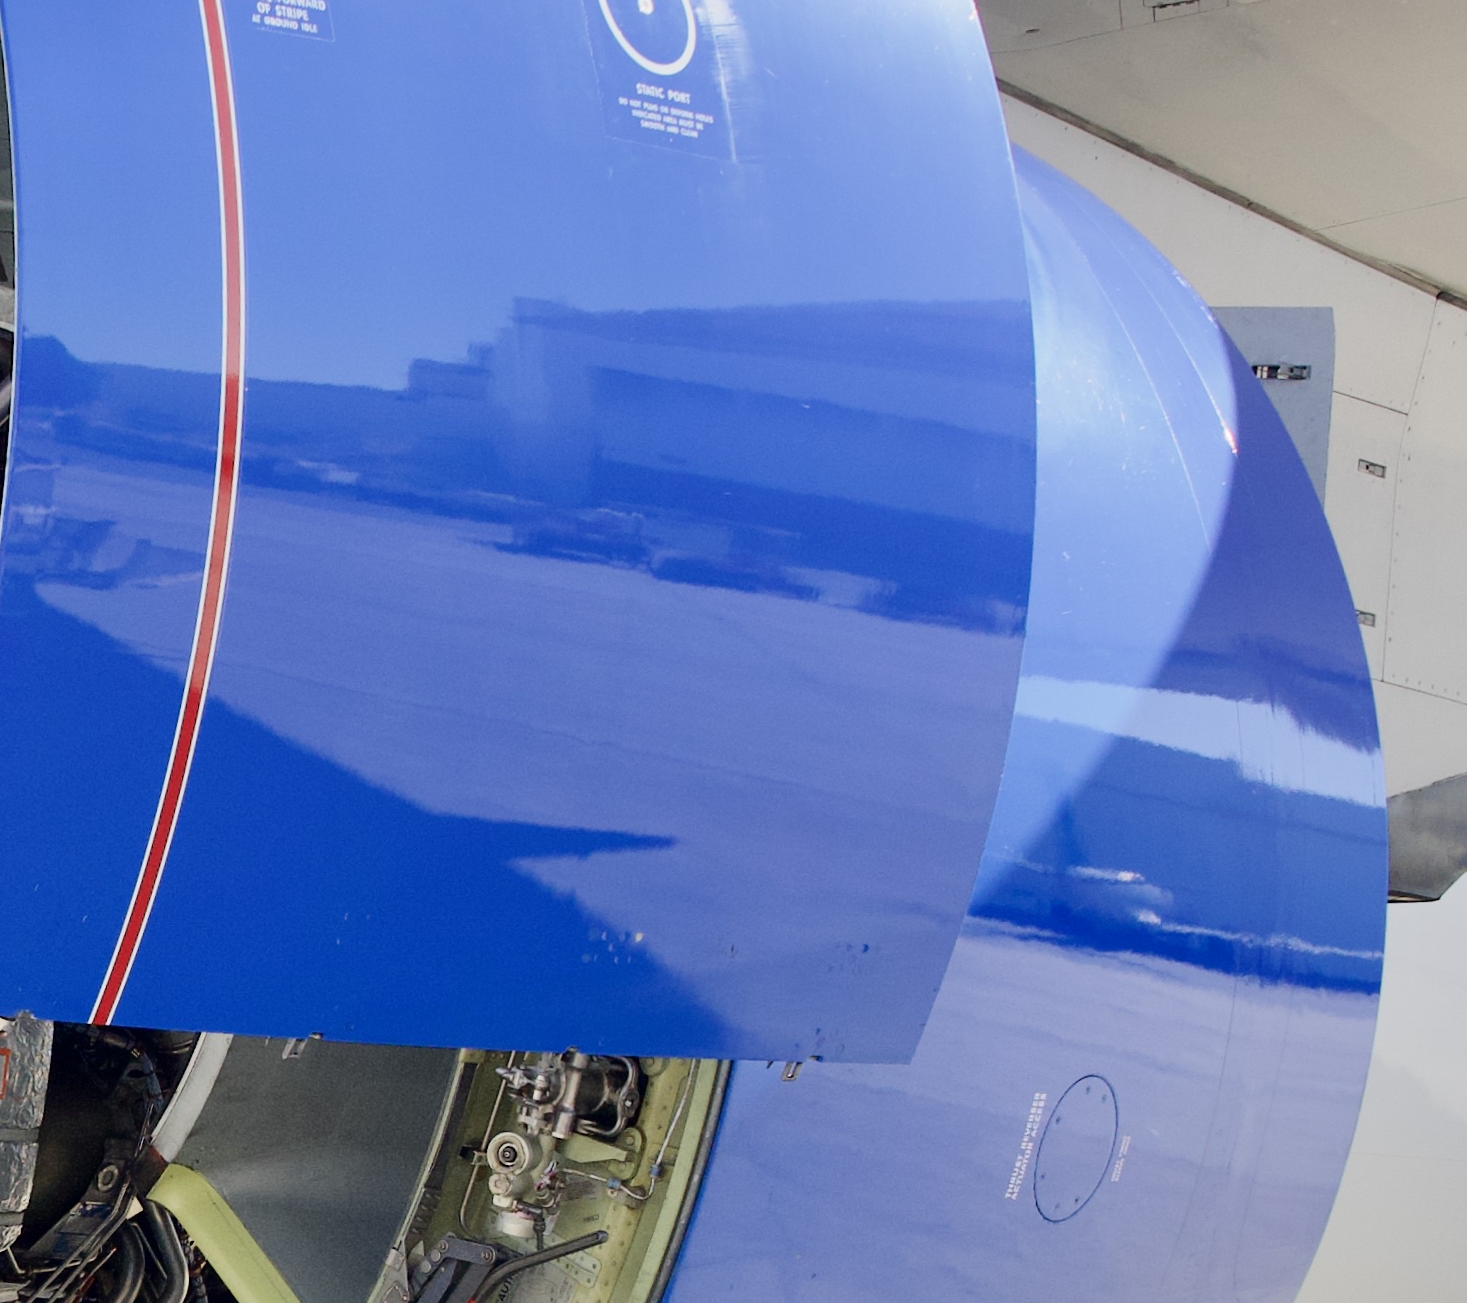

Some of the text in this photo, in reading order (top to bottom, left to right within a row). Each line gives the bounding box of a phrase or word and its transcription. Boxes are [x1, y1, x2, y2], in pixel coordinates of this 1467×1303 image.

[256, 1, 309, 21] OF STRIPE
[264, 16, 298, 30] GROUND
[636, 82, 691, 105] STATIC PORT
[1005, 1092, 1041, 1199] THRUST REVERSER
[1010, 1093, 1047, 1201] ACTUATOR ACCESS
